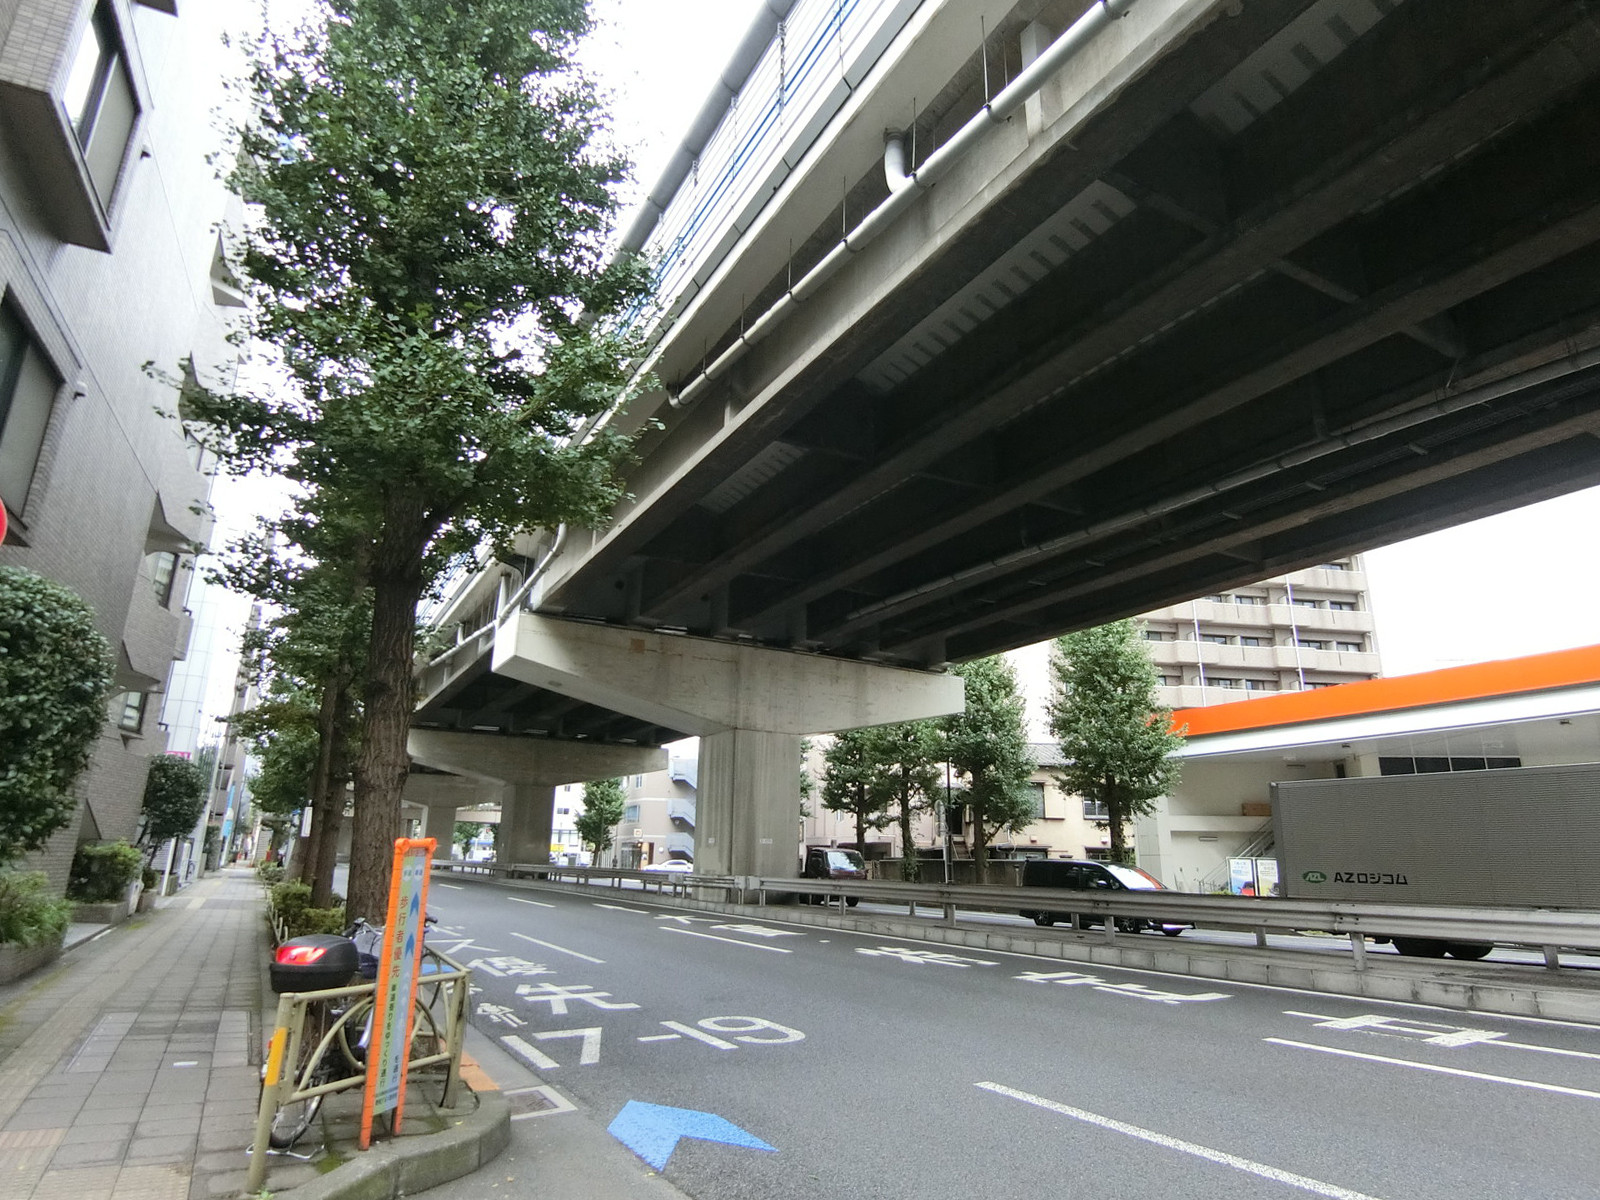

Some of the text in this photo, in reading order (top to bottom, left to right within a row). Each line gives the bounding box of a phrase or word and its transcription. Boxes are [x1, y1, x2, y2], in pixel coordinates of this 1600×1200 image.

[1305, 872, 1325, 882] AZL
[1334, 872, 1408, 885] AZロジコム
[391, 896, 409, 978] 歩行者優先
[500, 1015, 806, 1070] 17-19
